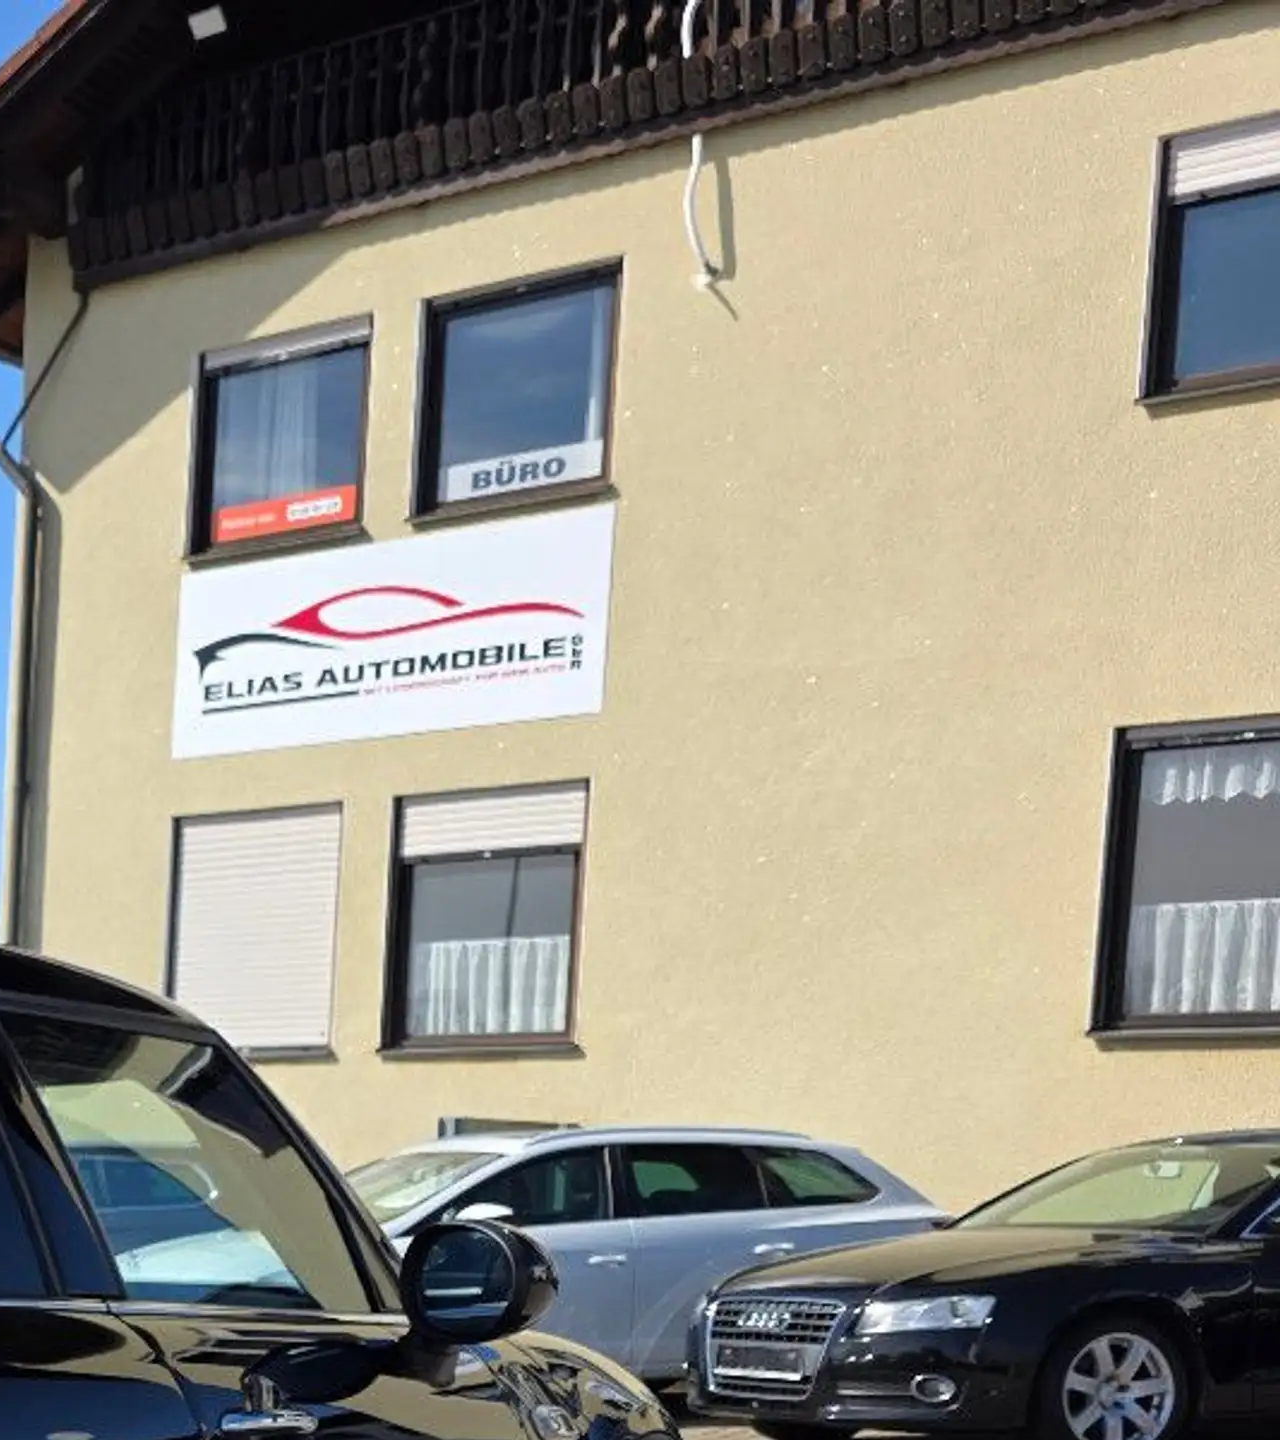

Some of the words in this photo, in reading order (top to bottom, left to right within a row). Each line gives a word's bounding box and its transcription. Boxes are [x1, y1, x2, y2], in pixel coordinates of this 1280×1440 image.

[472, 456, 566, 490] BÜRO
[204, 671, 302, 701] ELIAS
[316, 636, 567, 688] AUTOMOBILE
